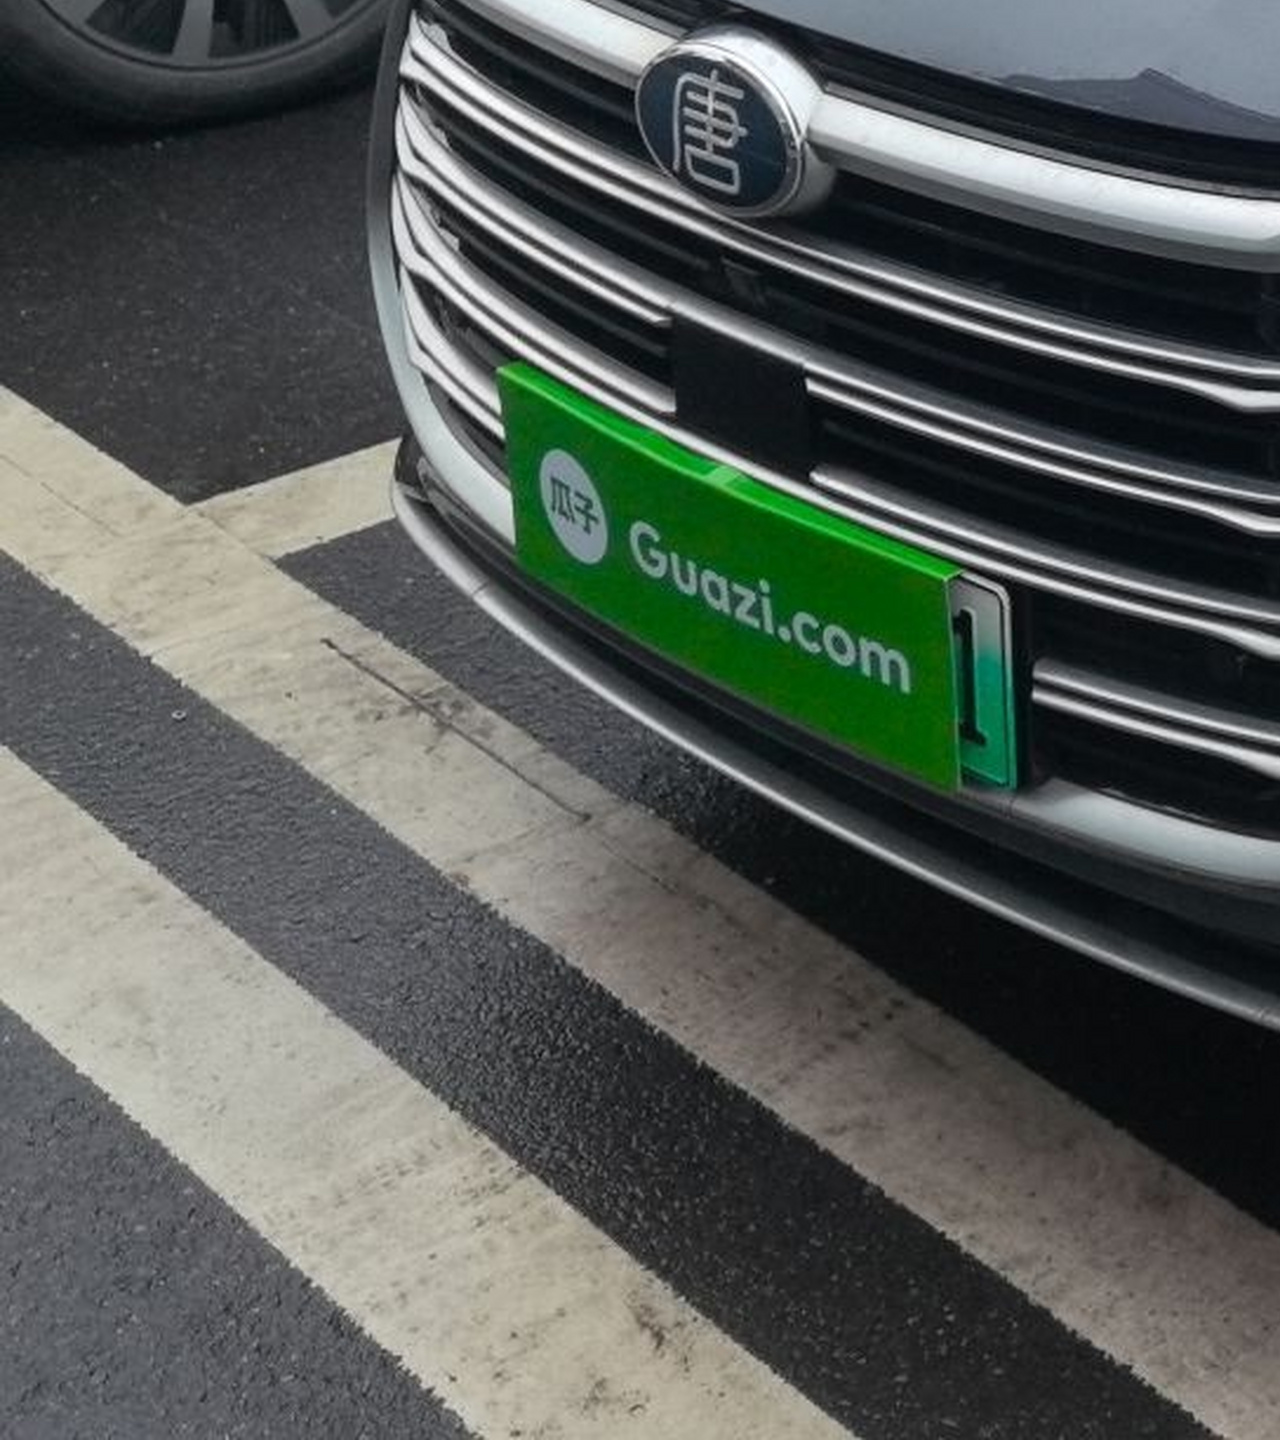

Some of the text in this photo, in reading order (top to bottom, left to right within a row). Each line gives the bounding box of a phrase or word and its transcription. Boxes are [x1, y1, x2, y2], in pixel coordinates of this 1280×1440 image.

[672, 69, 748, 195] 唐
[551, 477, 599, 536] 瓜子
[629, 519, 912, 695] Guazi.com
